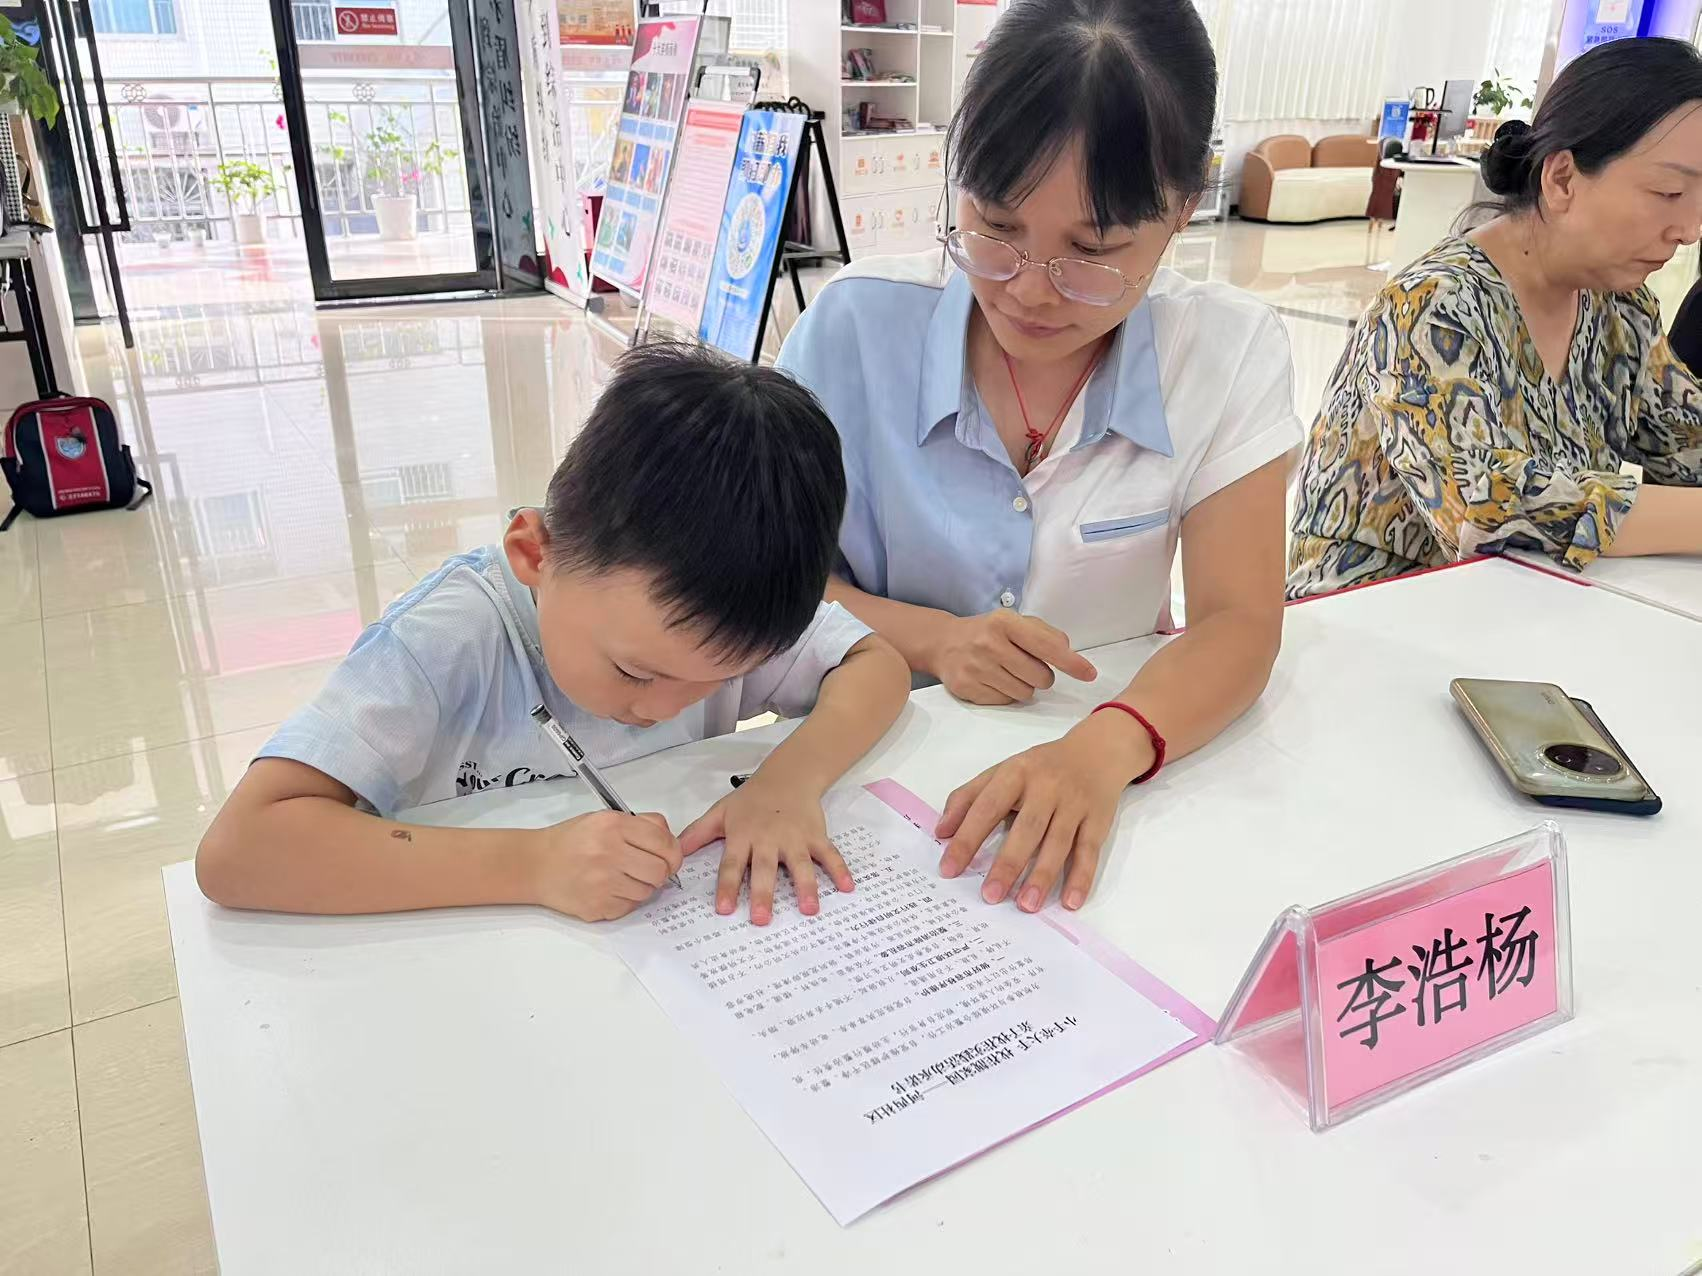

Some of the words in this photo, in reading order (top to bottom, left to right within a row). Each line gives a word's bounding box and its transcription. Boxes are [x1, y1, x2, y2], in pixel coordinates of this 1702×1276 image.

[1336, 905, 1539, 1049] 李浩杨
[891, 1021, 1031, 1093] 亲子找茬实践活动承诺书
[1016, 1015, 1077, 1049] 小手牵大手
